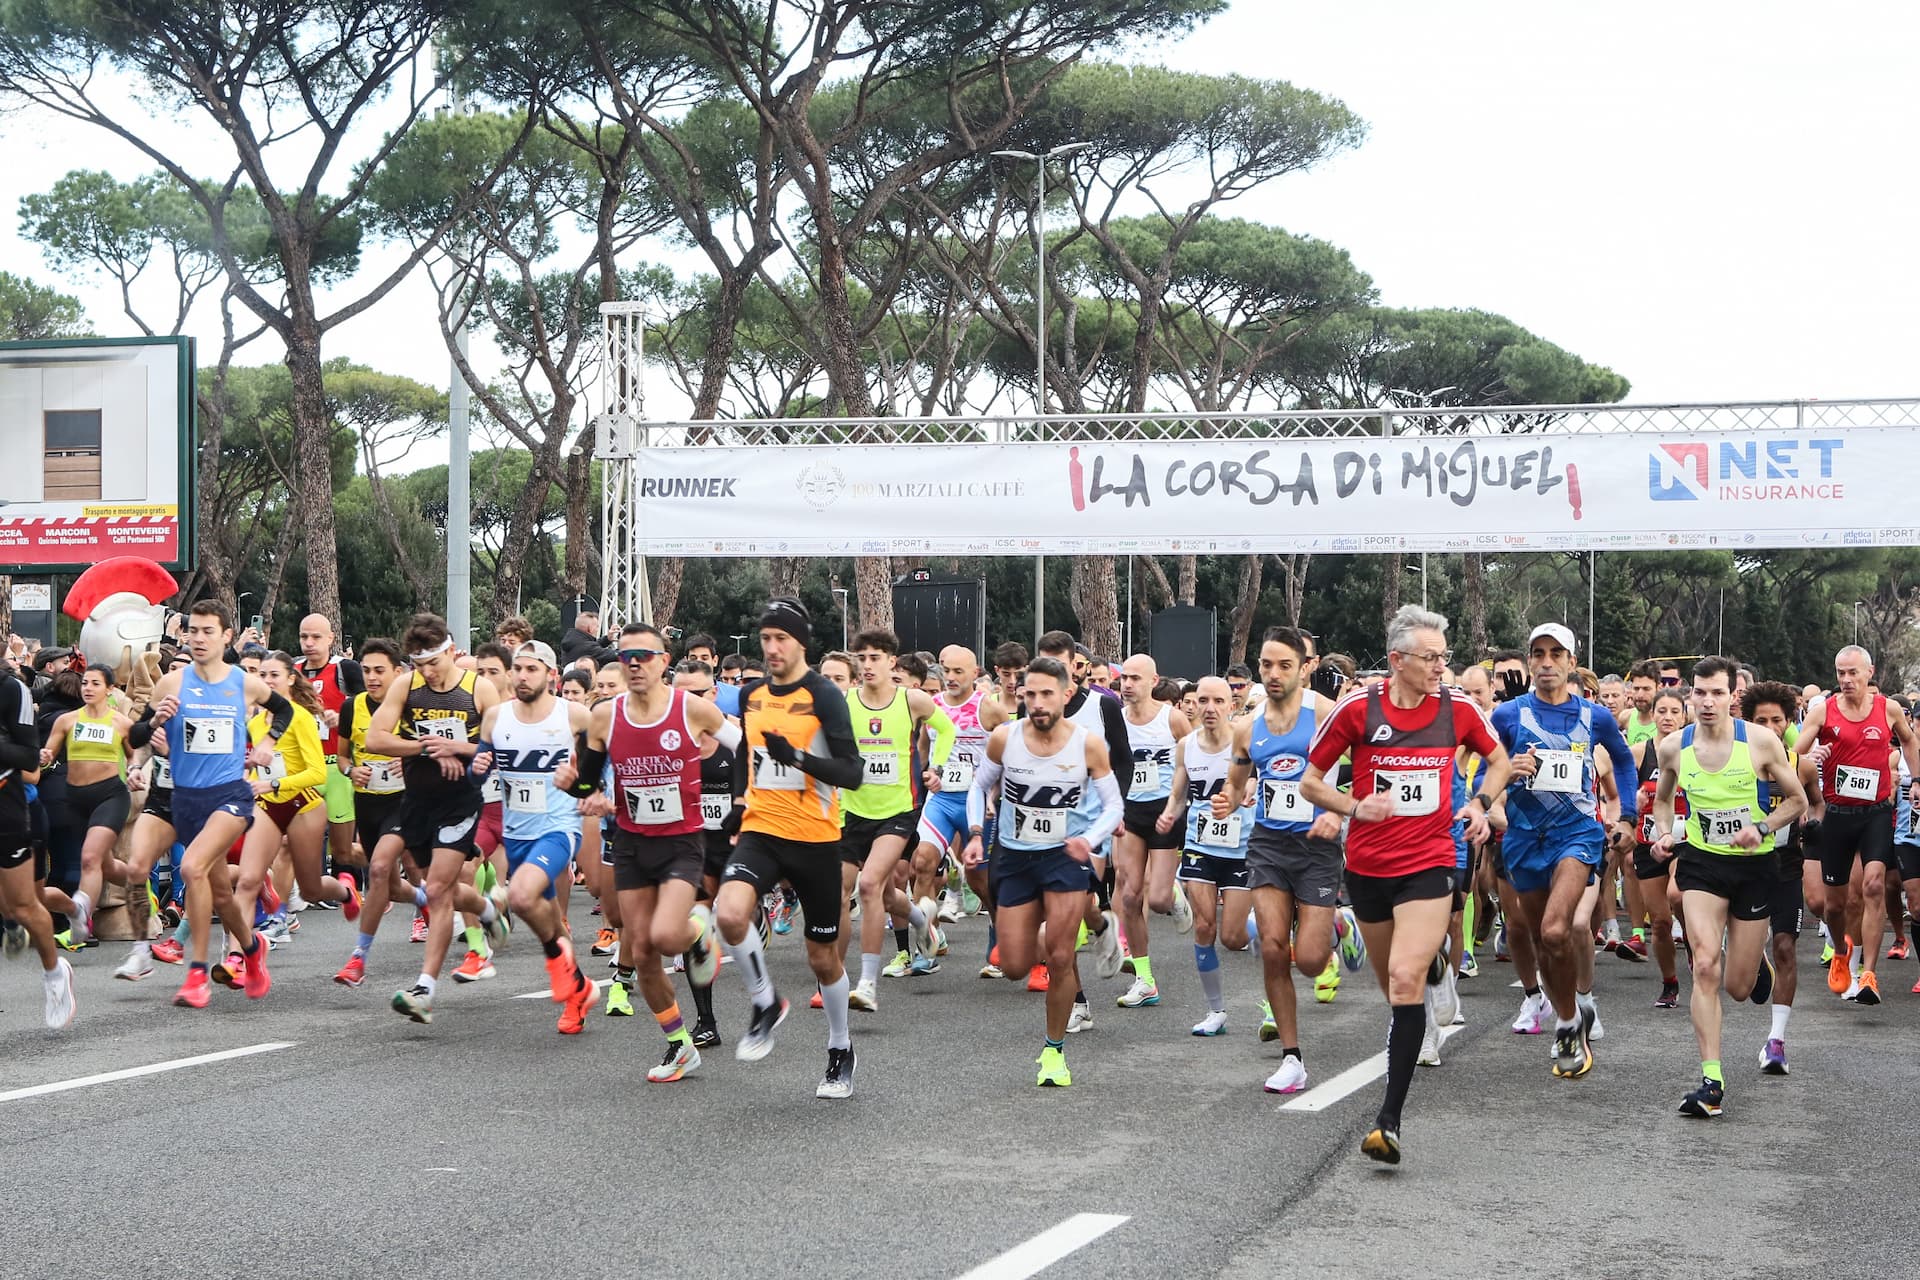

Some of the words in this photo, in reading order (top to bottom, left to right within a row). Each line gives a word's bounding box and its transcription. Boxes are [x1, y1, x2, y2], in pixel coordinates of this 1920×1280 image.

[1719, 439, 1844, 479] NET
[1165, 450, 1319, 506] CORSA
[641, 477, 737, 498] RUNNEK
[878, 483, 963, 497] MARZIALI
[968, 477, 1024, 497] CAFFÈ
[1719, 484, 1844, 501] INSURANCE
[85, 508, 112, 516] Trasporto
[118, 507, 148, 515] montaggio
[149, 507, 166, 515] gratis
[46, 528, 90, 536] MARCONI
[107, 527, 171, 535] MONTEVERDE
[1879, 529, 1914, 538] SPORT
[995, 539, 1015, 547] ICSC
[1021, 539, 1040, 547] Unar
[1504, 535, 1526, 543] Unar
[87, 728, 105, 739] 700
[208, 729, 216, 743] 3
[626, 755, 672, 766] ATLETICA
[1370, 754, 1449, 768] PUROSANGUE
[774, 761, 786, 777] 11
[869, 762, 890, 774] 444
[1552, 763, 1568, 779] 10
[381, 770, 389, 782] 4
[647, 775, 682, 785] STADIUM
[948, 771, 961, 783] 22
[1135, 771, 1147, 784] 37
[1851, 777, 1871, 790] 587
[518, 789, 530, 803] 17
[1401, 785, 1423, 802] 34
[648, 798, 665, 813] 12
[1286, 793, 1295, 809] 9
[702, 805, 722, 819] 138
[1033, 819, 1051, 833] 40
[1212, 822, 1228, 837] 38
[1716, 819, 1742, 835] 379
